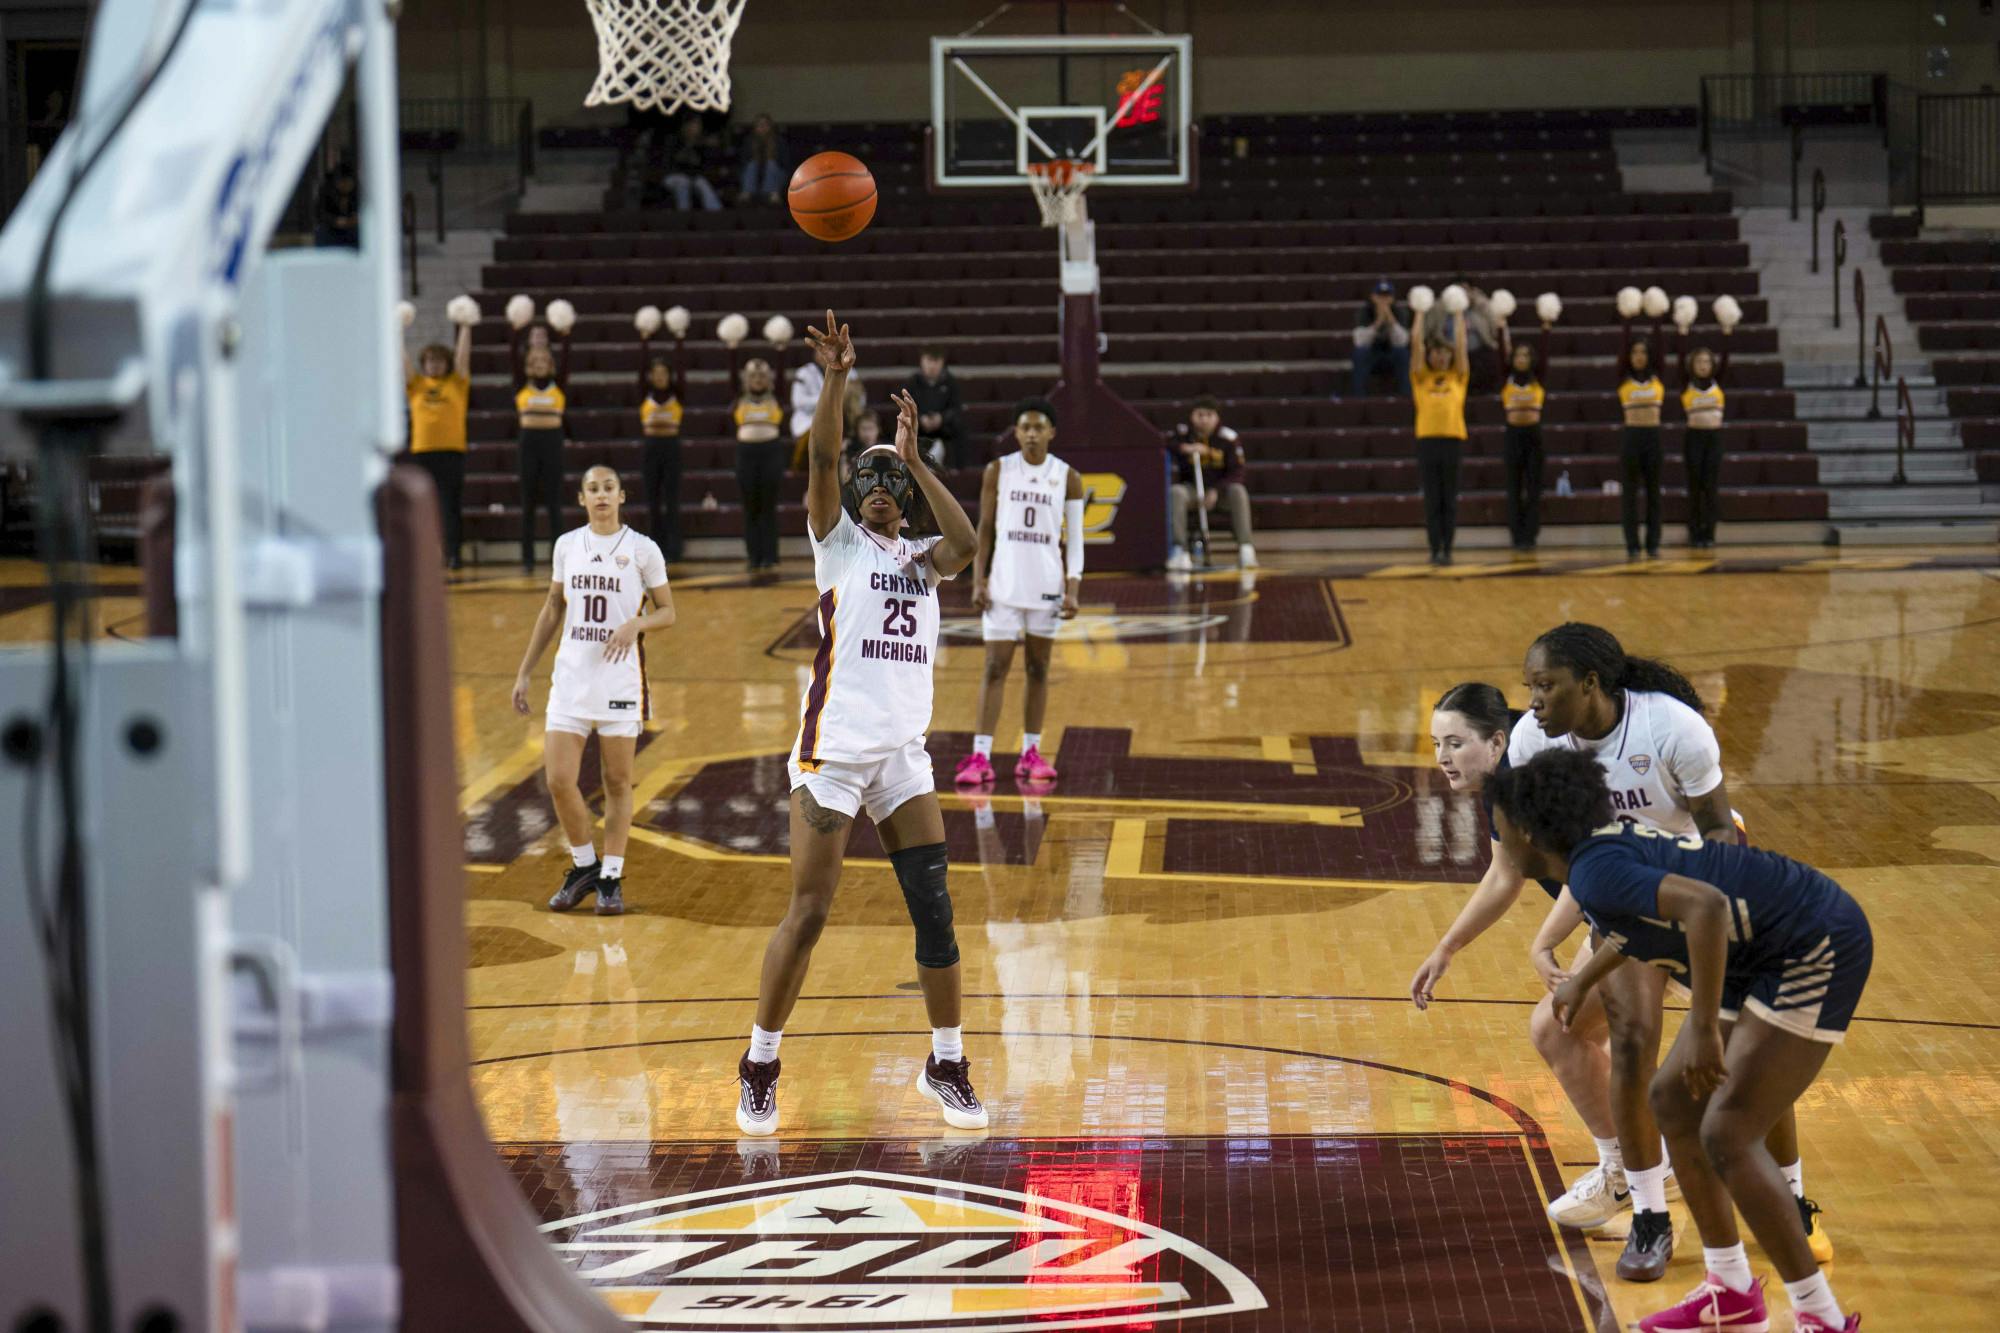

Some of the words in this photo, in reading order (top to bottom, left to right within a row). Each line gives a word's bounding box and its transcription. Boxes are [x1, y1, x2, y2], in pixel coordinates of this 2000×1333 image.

[1010, 490, 1053, 506] CENTRAL
[1024, 506, 1036, 528] 0
[1008, 530, 1051, 545] MICHIGAN
[571, 574, 622, 593] CENTRAL
[870, 571, 930, 597] CENTRAL
[583, 594, 607, 623] 10
[883, 597, 917, 638] 25
[861, 638, 928, 665] MICHIGAN
[683, 1293, 907, 1310] 1946
